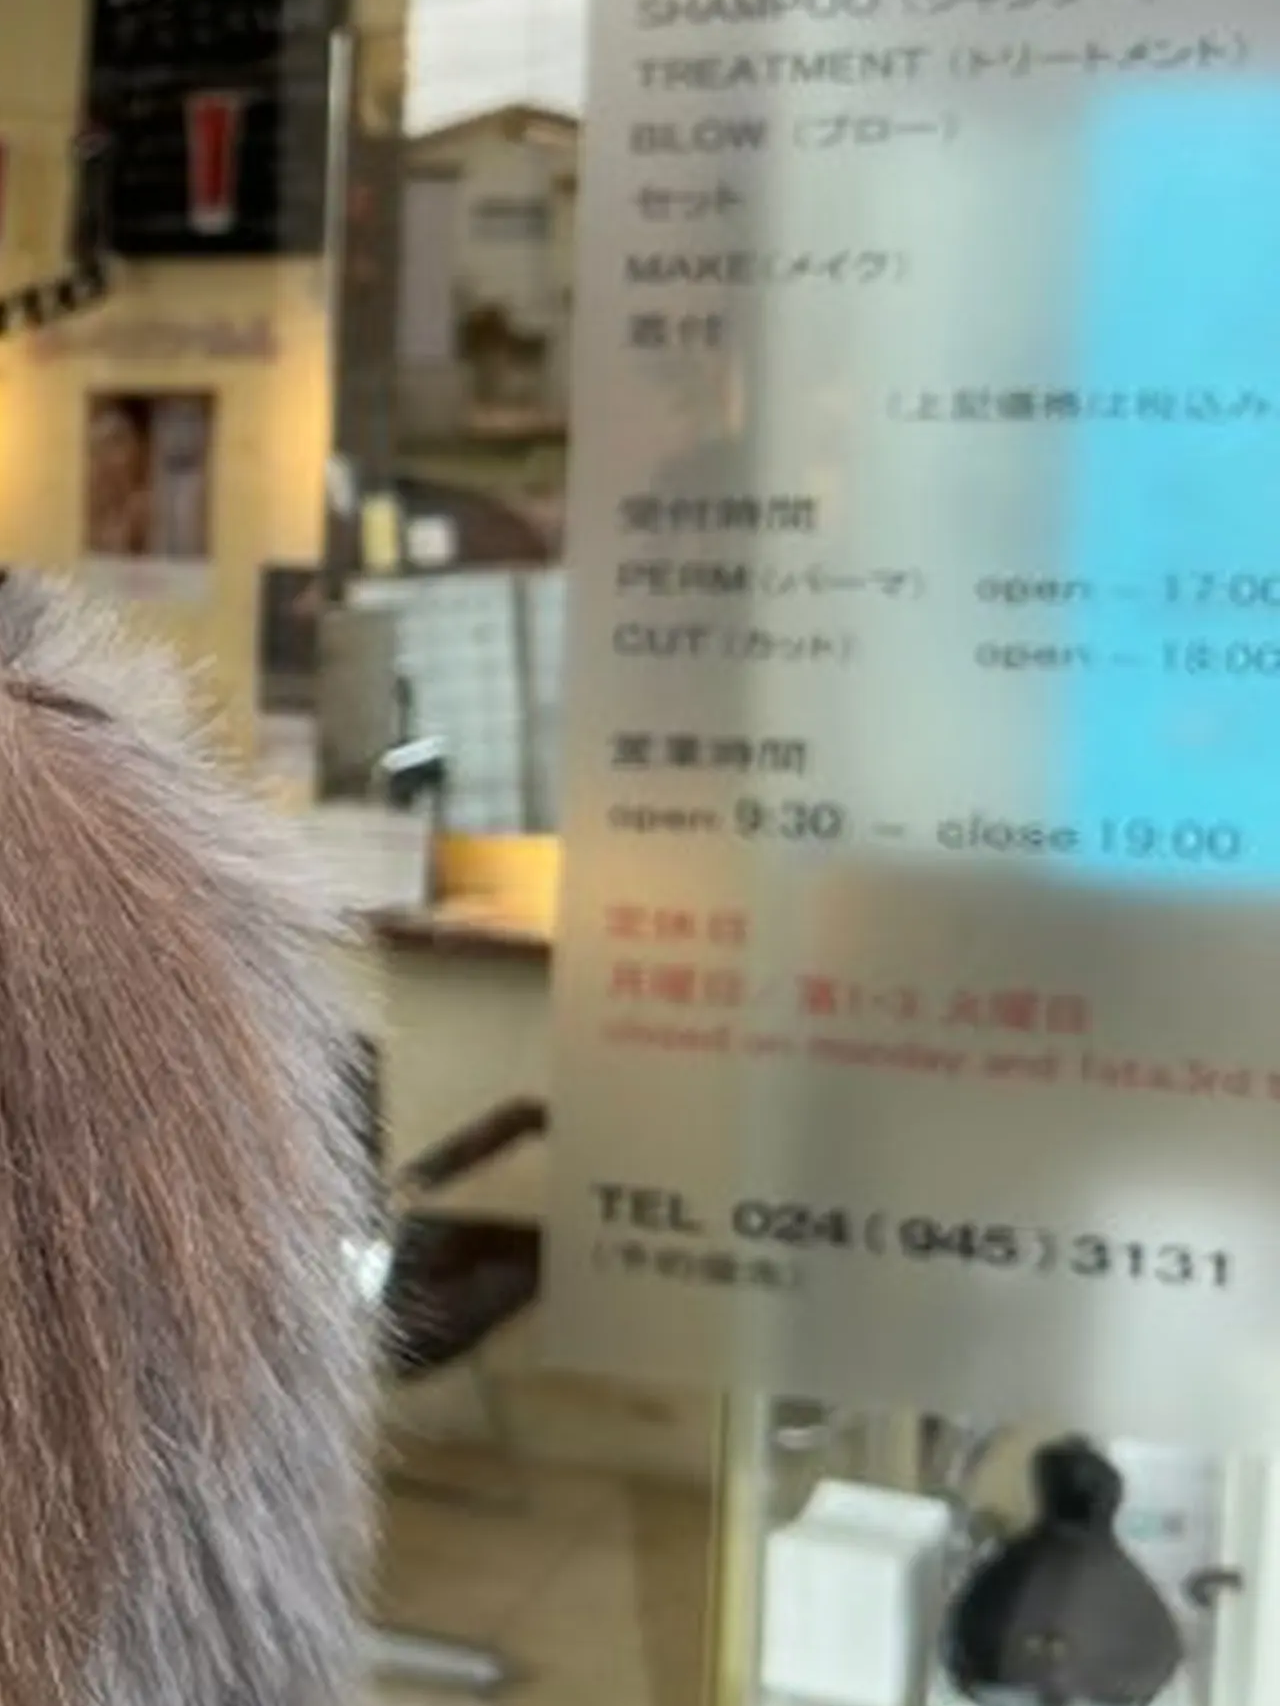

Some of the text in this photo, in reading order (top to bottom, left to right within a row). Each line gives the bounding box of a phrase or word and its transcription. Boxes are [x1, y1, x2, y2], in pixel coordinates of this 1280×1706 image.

[634, 45, 929, 90] TREATMENT
[630, 118, 766, 157] BLOW
[625, 249, 757, 284] MAKE
[617, 560, 751, 597] PERM
[613, 624, 711, 660] CUT
[608, 805, 718, 837] open
[735, 801, 842, 840] 9:30
[936, 809, 1081, 854] close
[1100, 821, 1241, 862] 19:00
[592, 1181, 703, 1234] TEL
